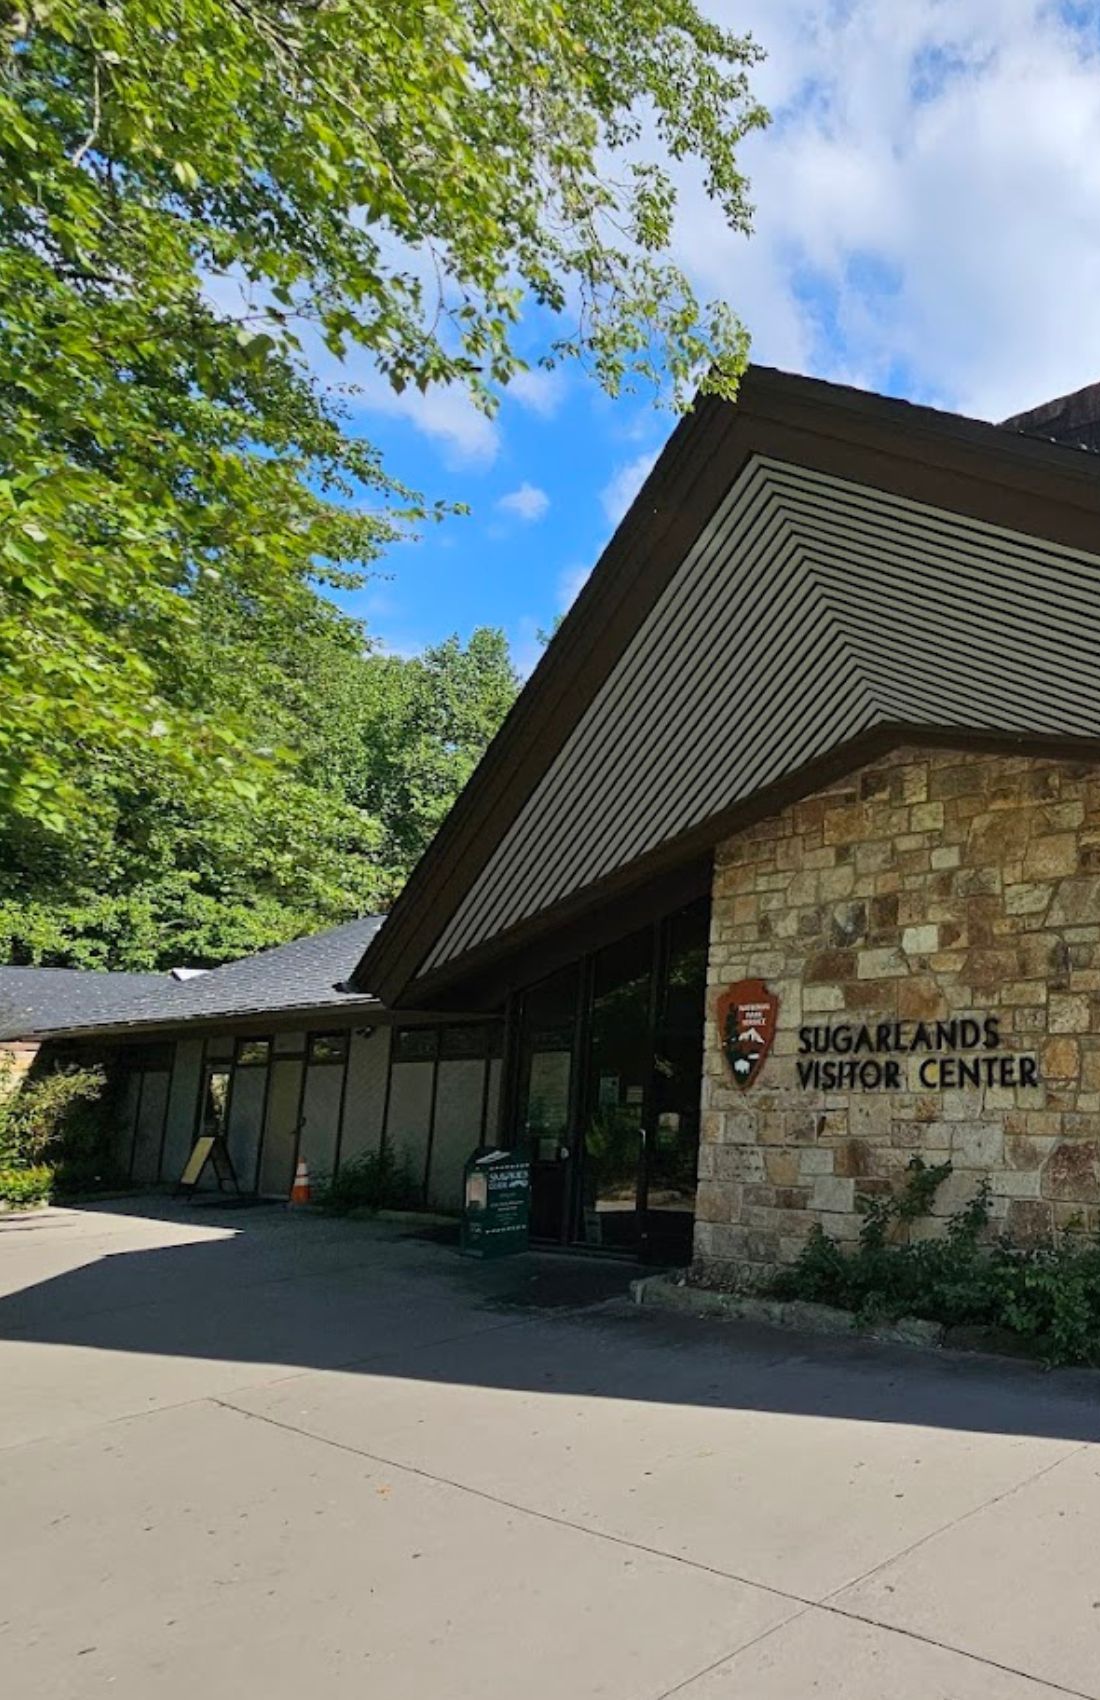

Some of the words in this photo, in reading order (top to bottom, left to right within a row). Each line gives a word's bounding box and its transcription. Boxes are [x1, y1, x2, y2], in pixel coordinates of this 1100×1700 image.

[797, 1018, 1000, 1053] SUGARLANDS
[796, 1059, 901, 1090] VISITOR
[918, 1056, 1039, 1089] CENTER
